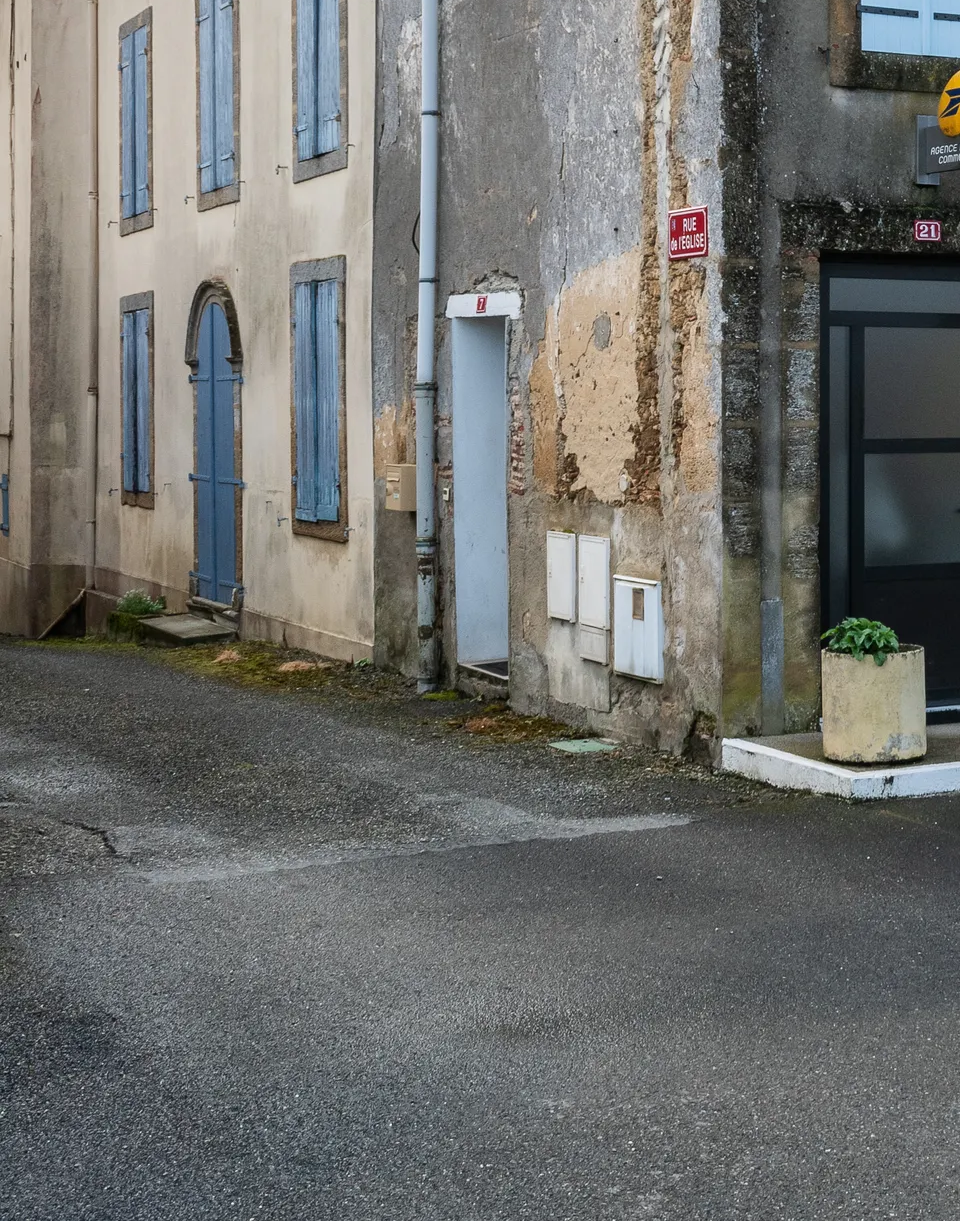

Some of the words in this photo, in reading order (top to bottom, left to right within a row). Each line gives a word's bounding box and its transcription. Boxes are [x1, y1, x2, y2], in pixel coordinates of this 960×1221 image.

[930, 143, 958, 156] AGENCE
[682, 216, 697, 232] RUE
[919, 224, 936, 238] 21
[670, 237, 678, 251] de
